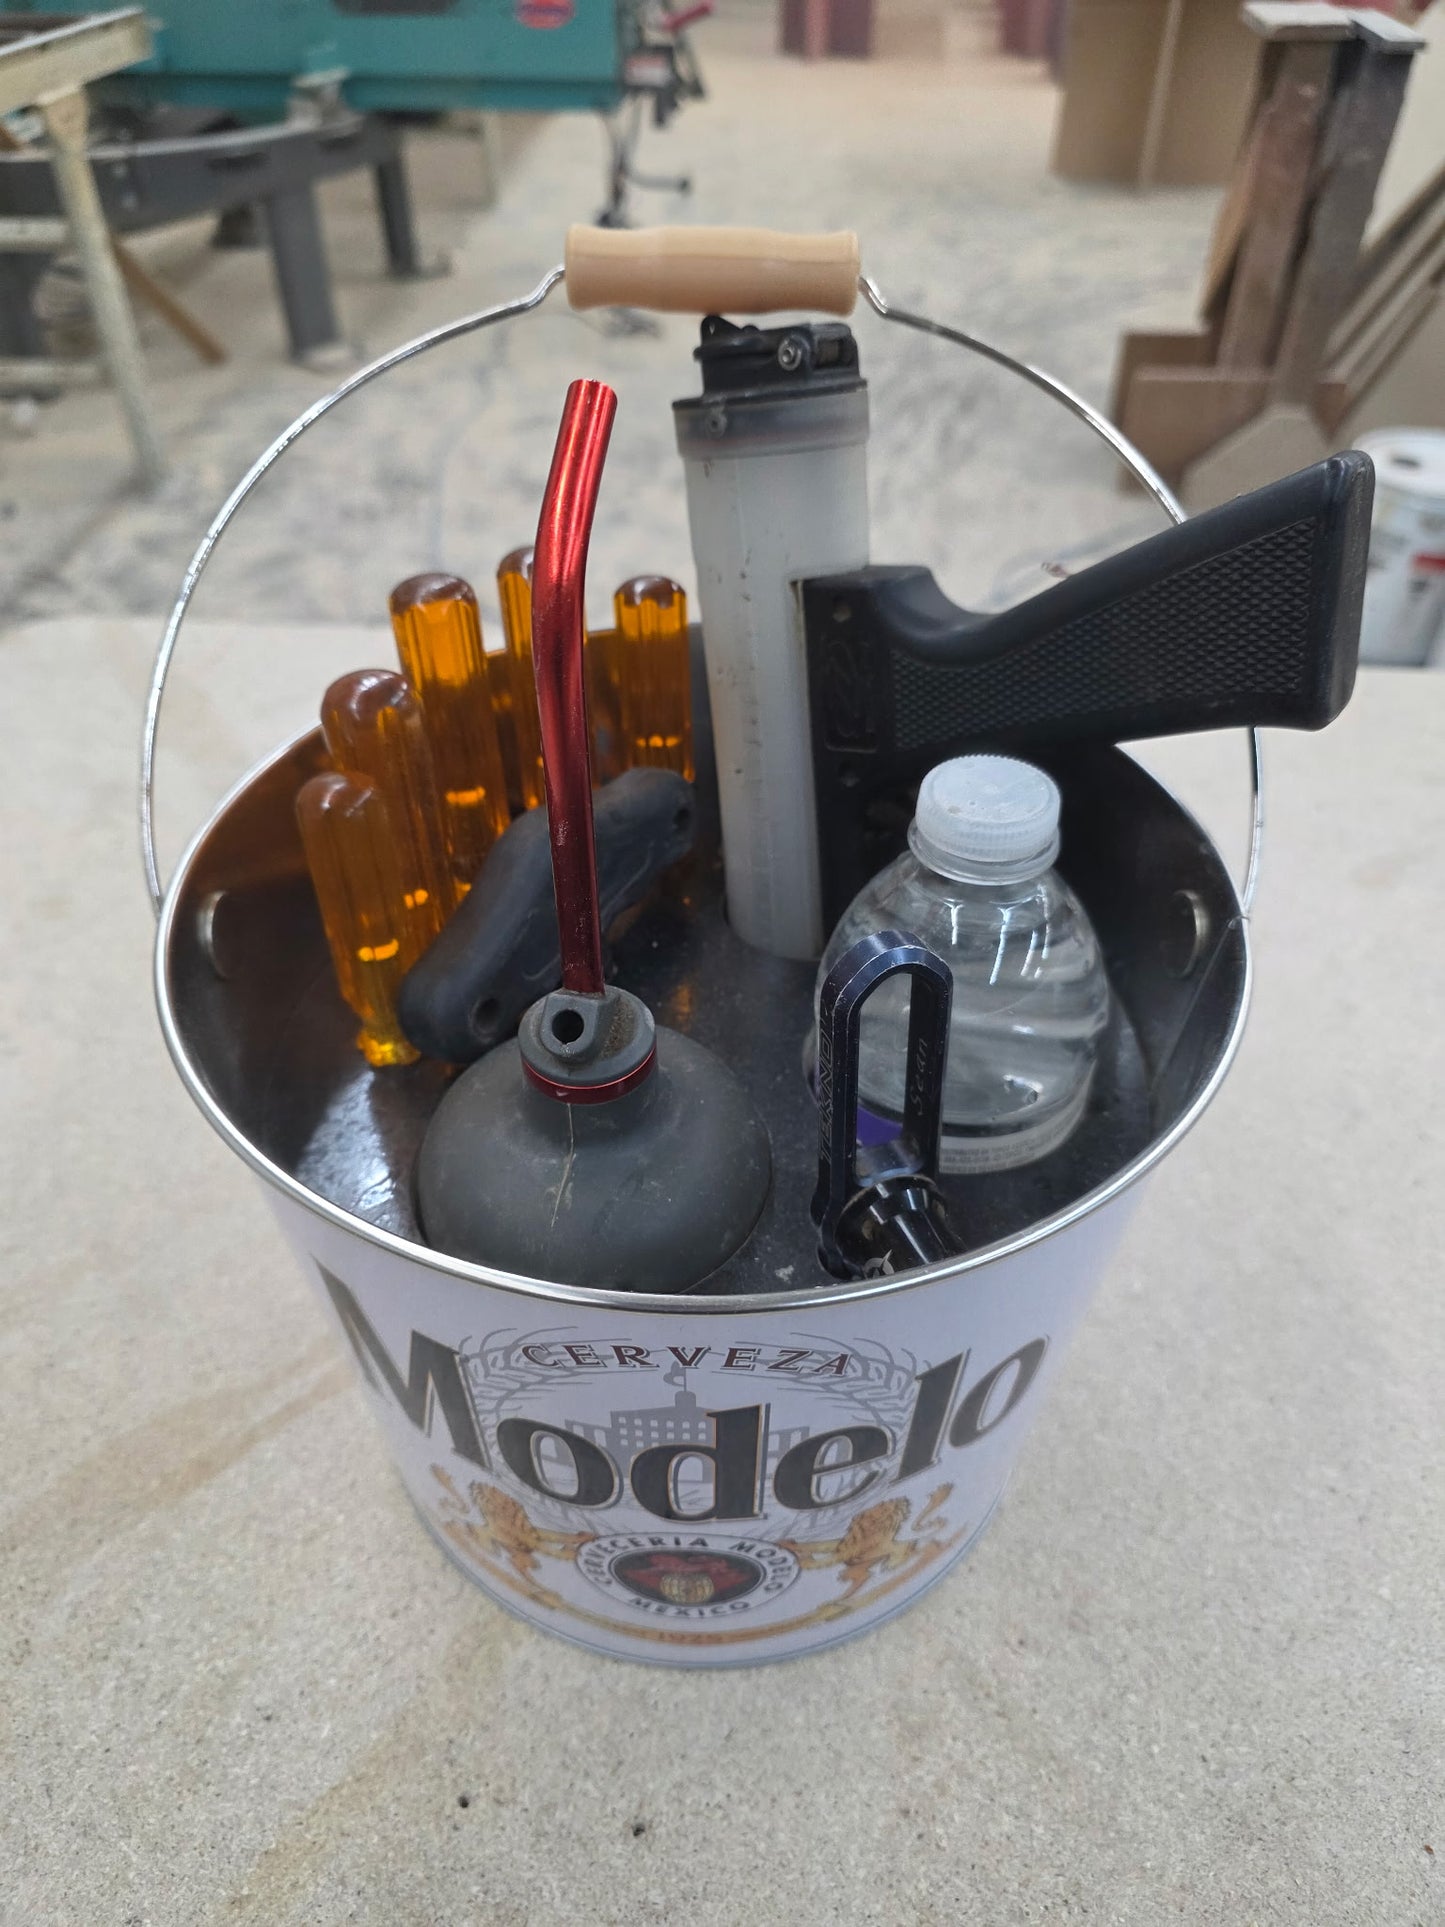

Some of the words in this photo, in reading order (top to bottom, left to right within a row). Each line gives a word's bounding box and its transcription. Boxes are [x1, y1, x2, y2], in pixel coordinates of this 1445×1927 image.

[521, 1344, 851, 1377] CERVEZA
[312, 1254, 1049, 1522] Modelo
[727, 1541, 794, 1592] MODELO
[629, 1597, 750, 1618] MEXICO
